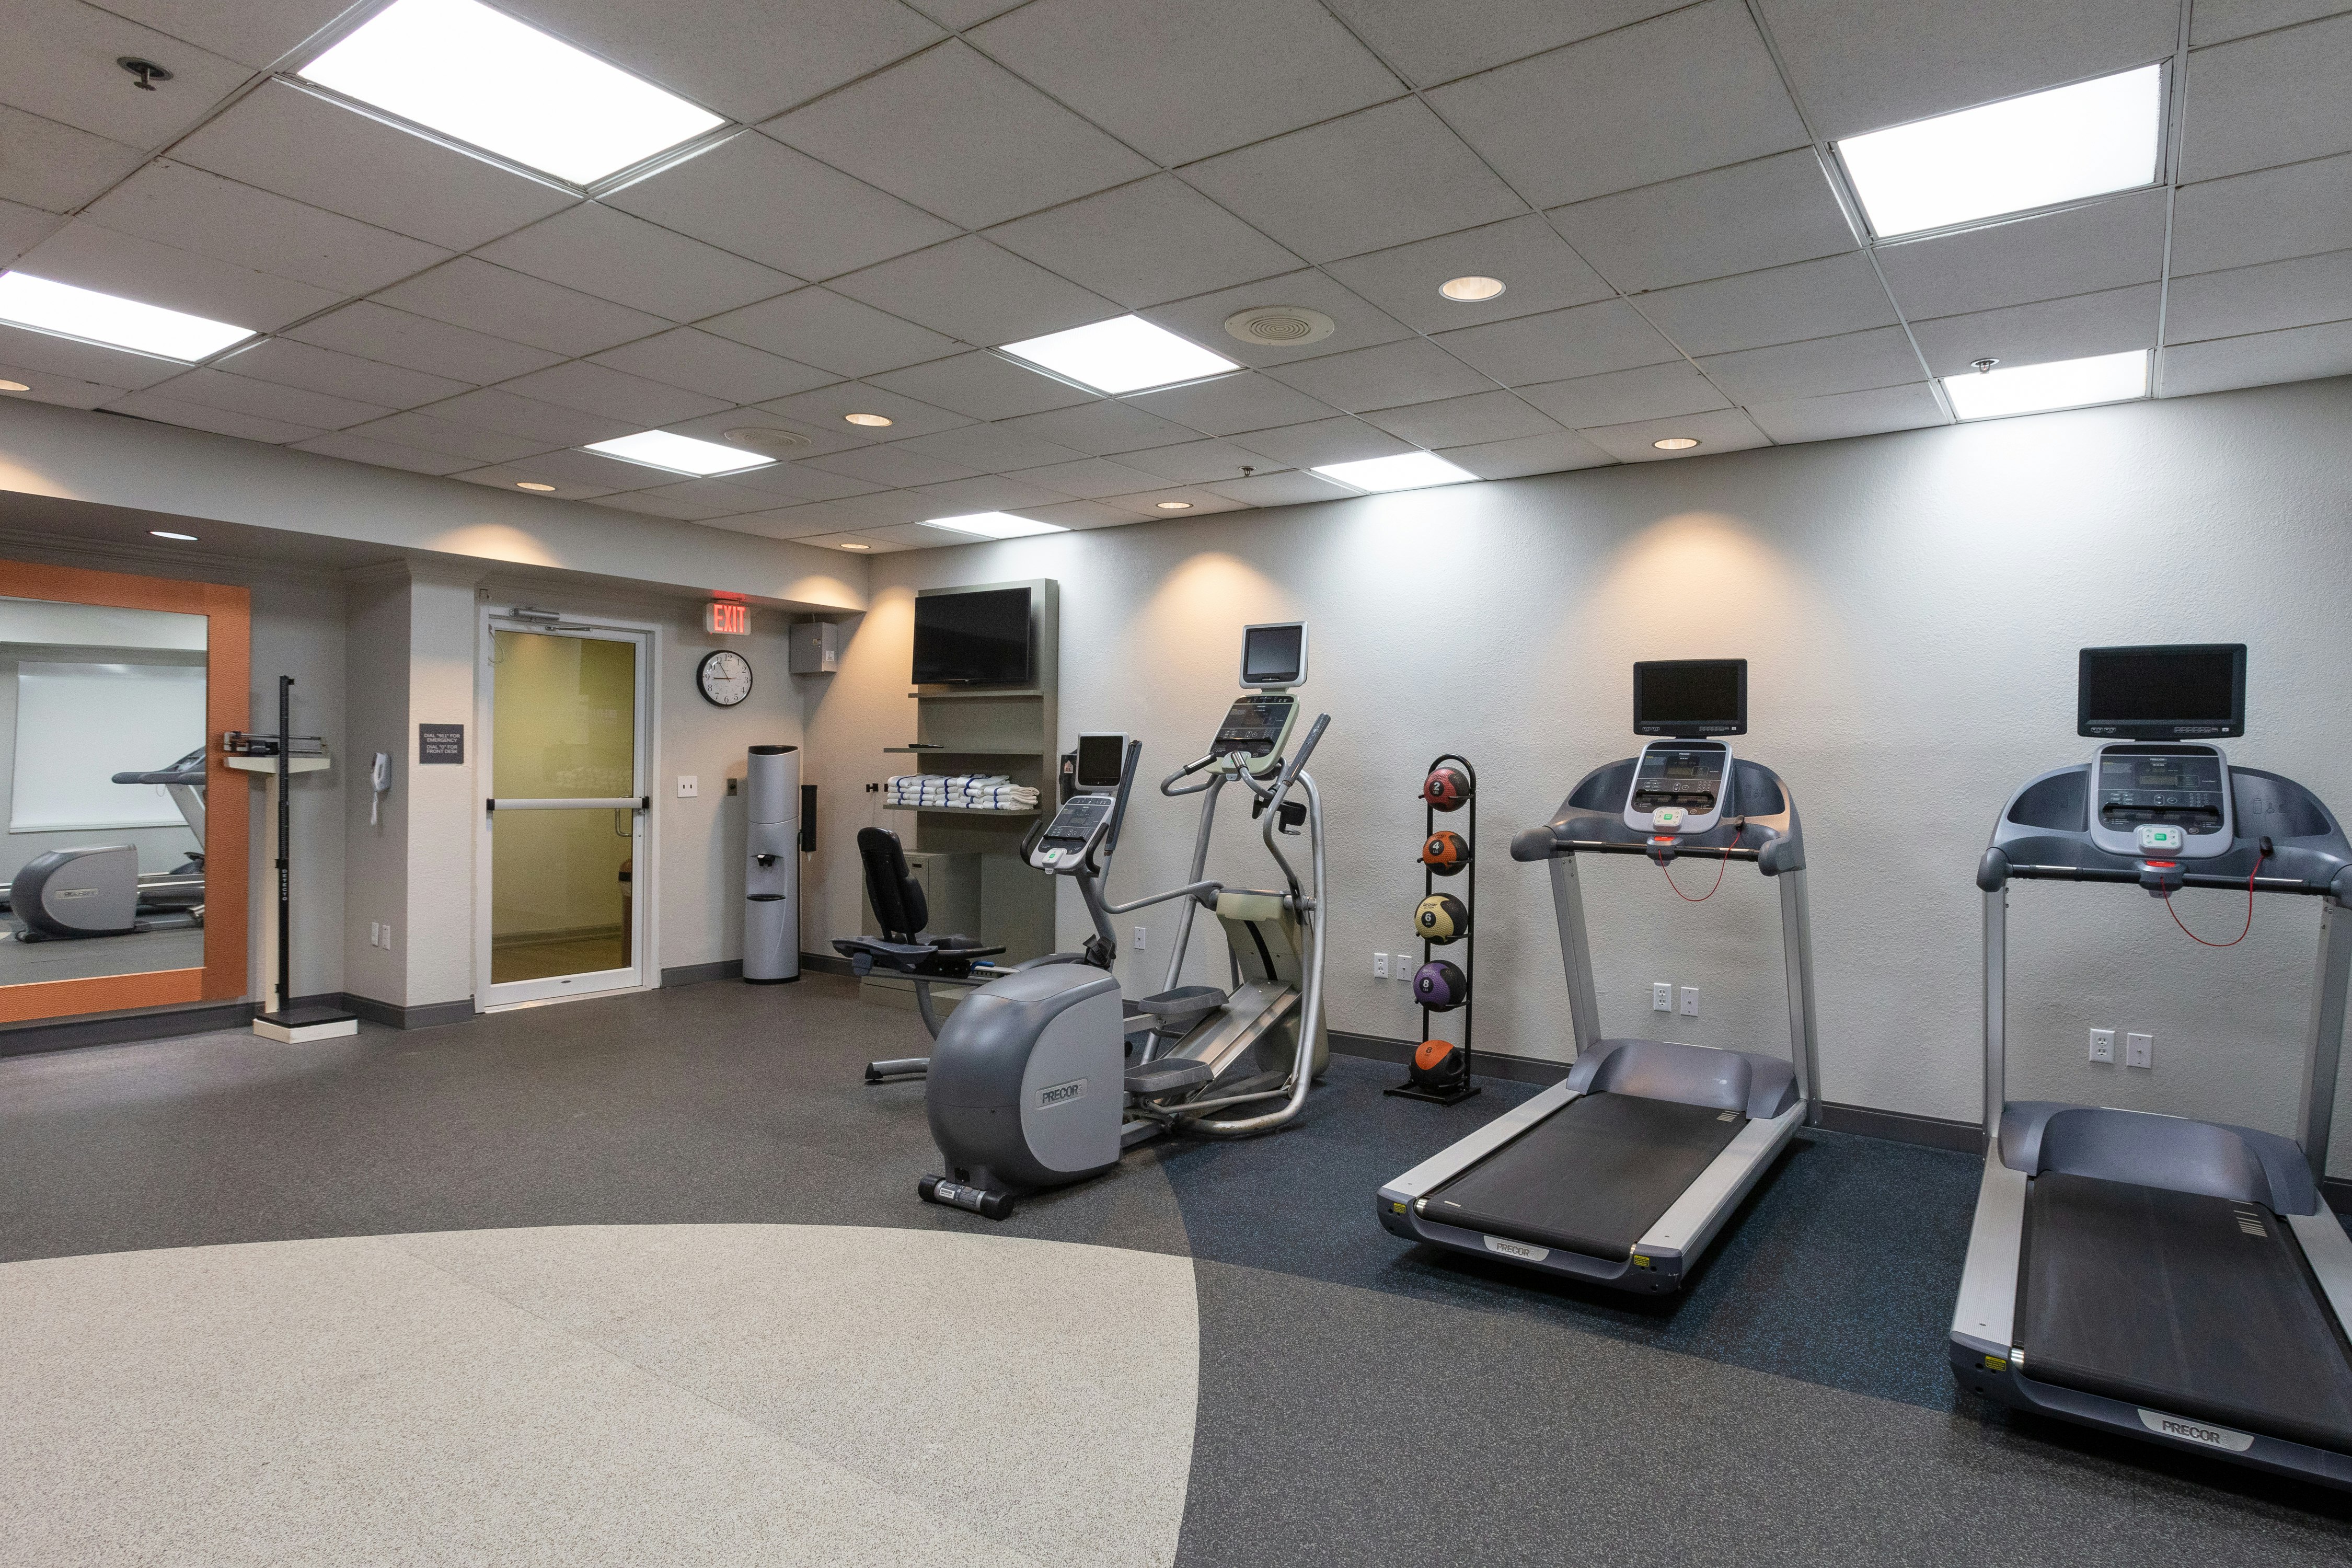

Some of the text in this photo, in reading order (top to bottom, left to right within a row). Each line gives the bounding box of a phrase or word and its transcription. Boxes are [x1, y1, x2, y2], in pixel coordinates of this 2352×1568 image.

[714, 604, 745, 632] EXIT
[1434, 782, 1440, 791] 2
[1432, 841, 1439, 850] 4
[1425, 913, 1432, 922] 6
[1423, 979, 1429, 988] 8
[1042, 1085, 1078, 1103] PRECOR
[1496, 1242, 1530, 1257] PRECOR
[2162, 1420, 2220, 1444] PRECOR
